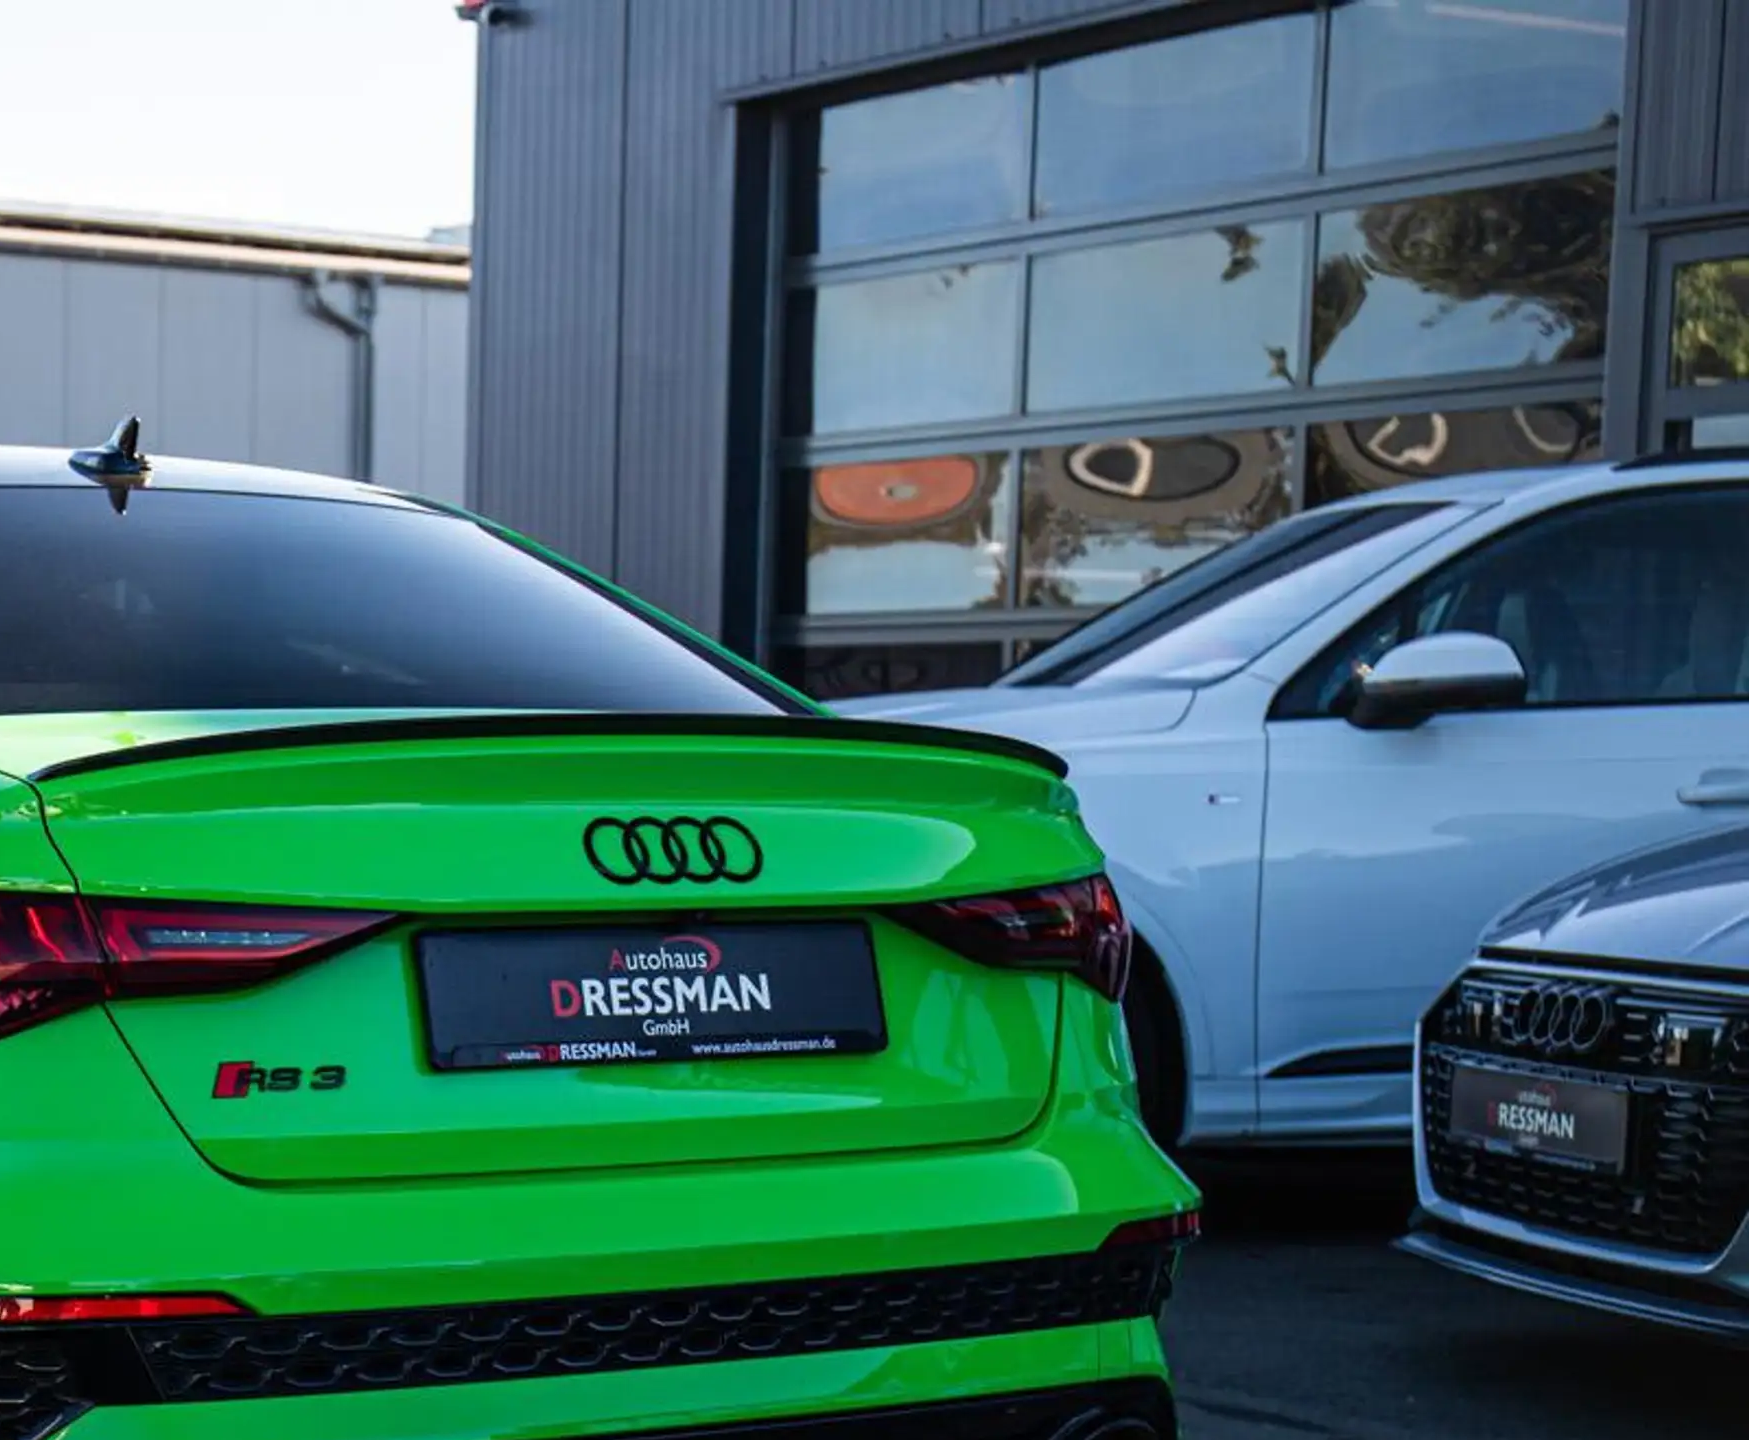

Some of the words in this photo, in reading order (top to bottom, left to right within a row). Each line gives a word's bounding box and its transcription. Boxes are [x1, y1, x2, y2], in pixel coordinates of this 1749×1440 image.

[609, 946, 708, 971] Autohaus
[549, 973, 772, 1018] DRESSMAN
[643, 1018, 691, 1037] GmbH
[547, 1041, 637, 1063] DRESSMAN
[231, 1065, 303, 1098] RS
[309, 1064, 347, 1091] 3
